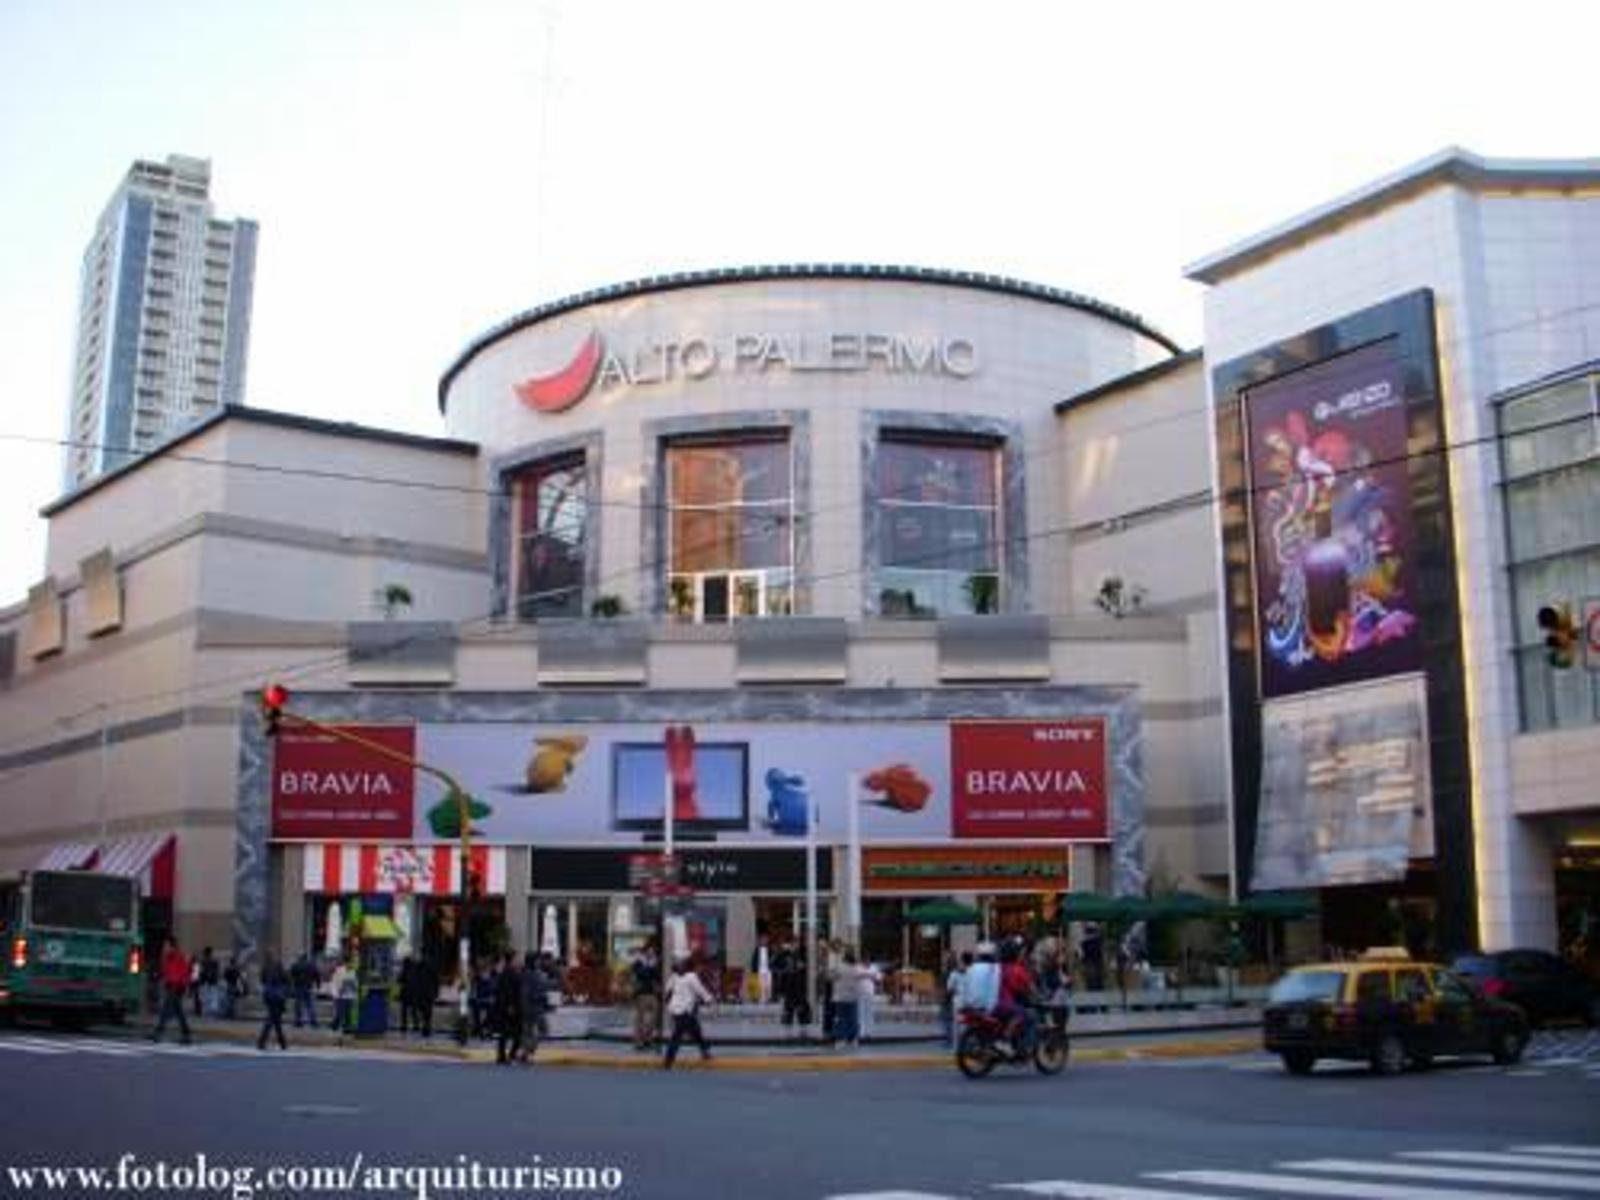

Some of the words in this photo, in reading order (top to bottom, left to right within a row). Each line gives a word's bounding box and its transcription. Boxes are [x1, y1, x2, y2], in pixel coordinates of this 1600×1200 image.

[598, 335, 718, 386] ALTO
[733, 333, 977, 378] PALERMO
[1033, 728, 1094, 741] SONY
[280, 770, 393, 796] BRAVIA
[966, 770, 1086, 794] BRAVIA
